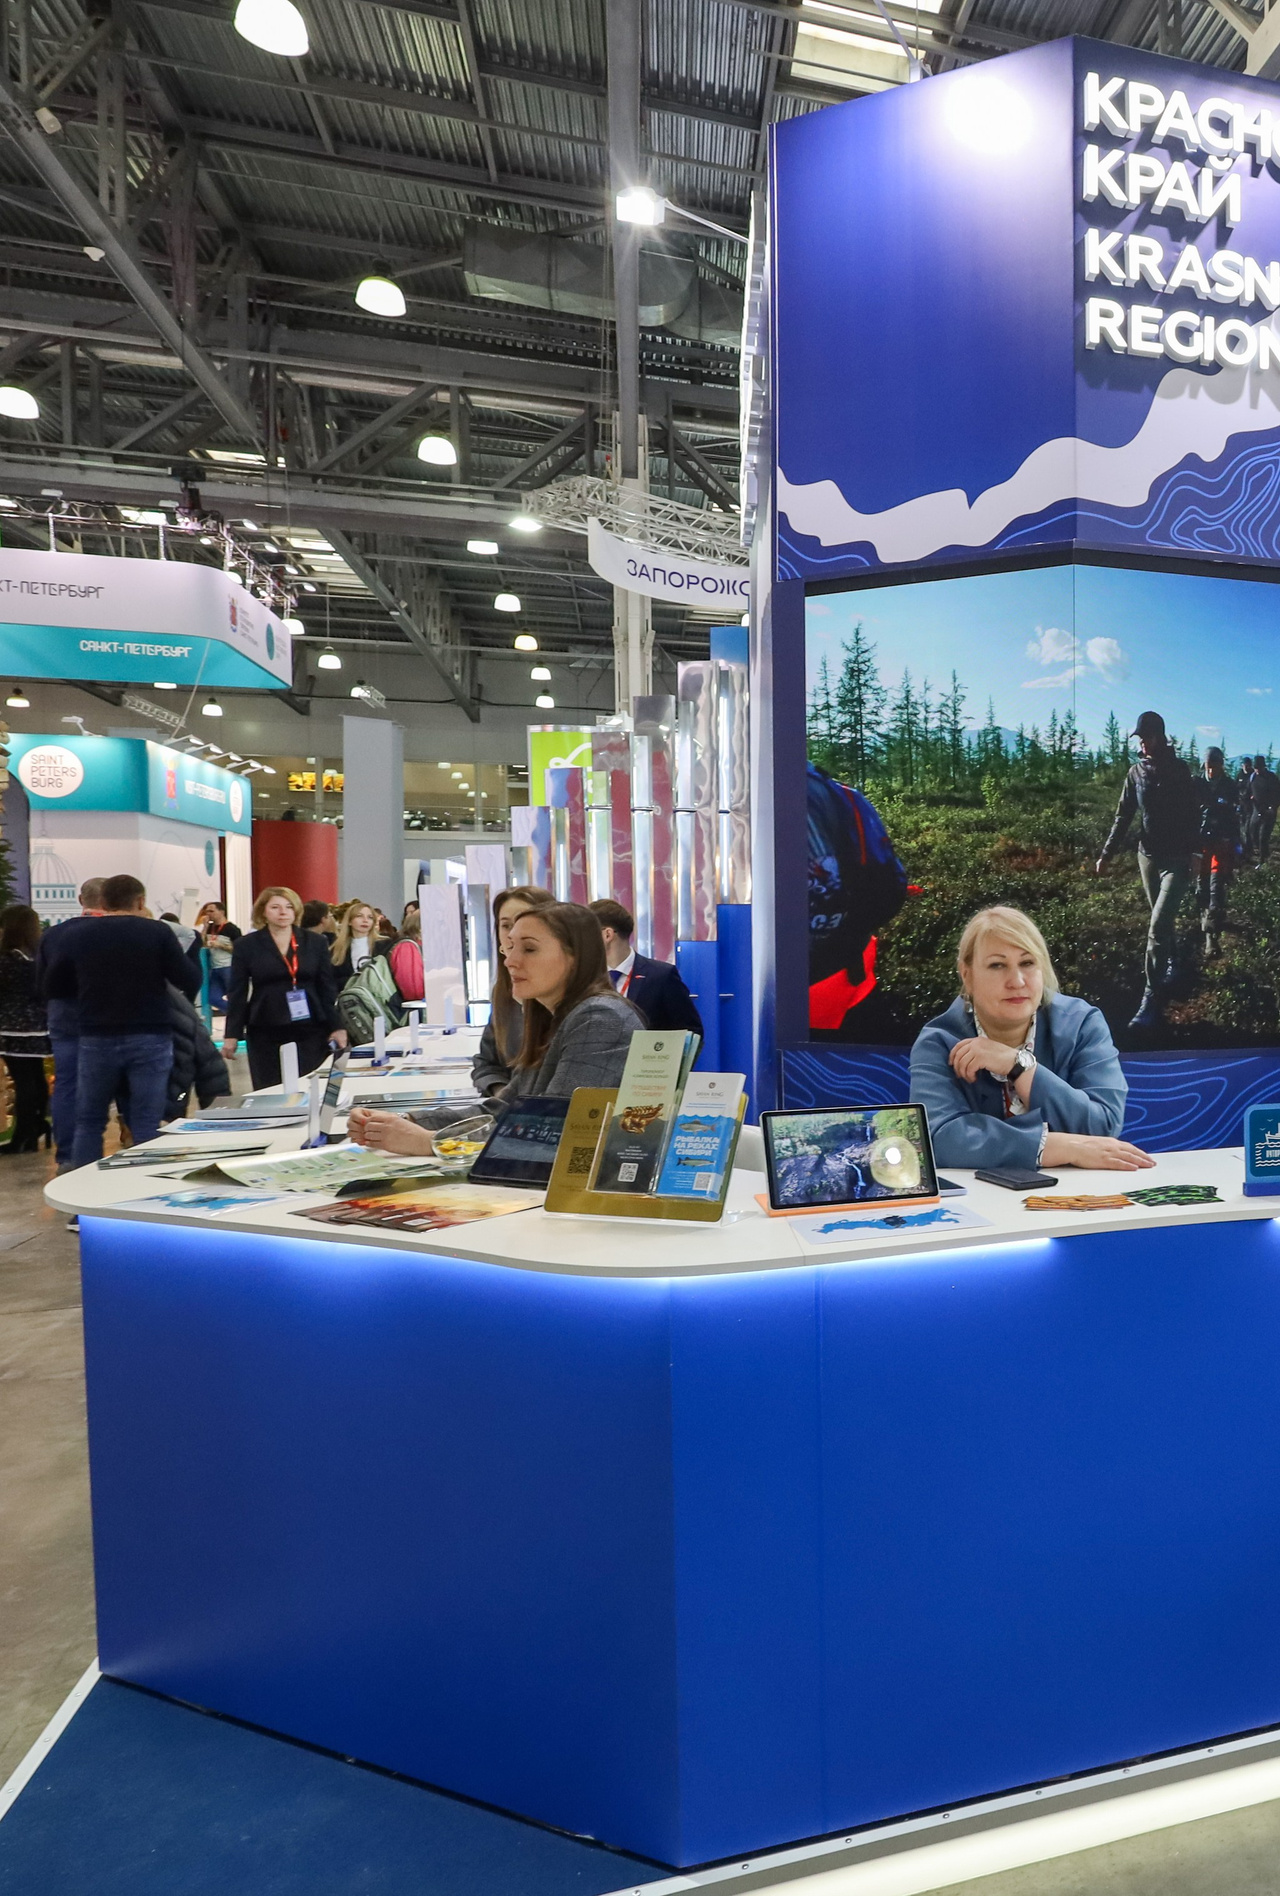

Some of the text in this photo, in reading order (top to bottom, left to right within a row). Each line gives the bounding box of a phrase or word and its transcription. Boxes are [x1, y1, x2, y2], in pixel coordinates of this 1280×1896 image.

[1083, 144, 1241, 228] КРАЙ
[79, 639, 193, 658] САНКТ-ПЕТЕРБУРГ
[30, 754, 65, 765] SAINT
[30, 765, 78, 778] PETERS
[30, 777, 64, 788] BURG
[674, 1135, 721, 1144] РЫБАЛКА
